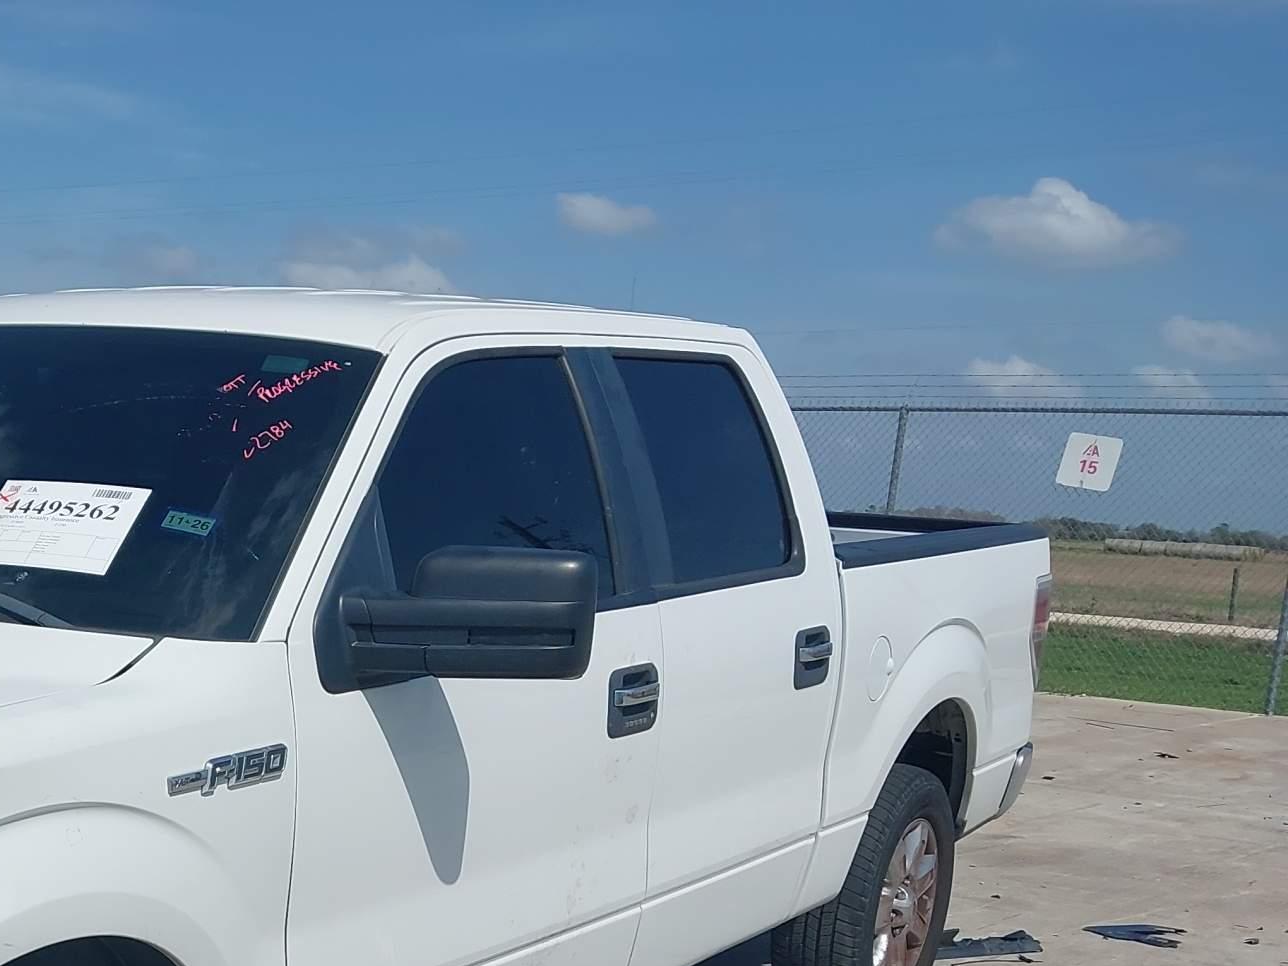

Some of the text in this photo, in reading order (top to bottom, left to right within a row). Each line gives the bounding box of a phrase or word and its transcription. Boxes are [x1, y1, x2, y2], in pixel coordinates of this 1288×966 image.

[1079, 459, 1099, 475] 15
[4, 499, 120, 522] 44495262
[168, 515, 211, 530] 11-26
